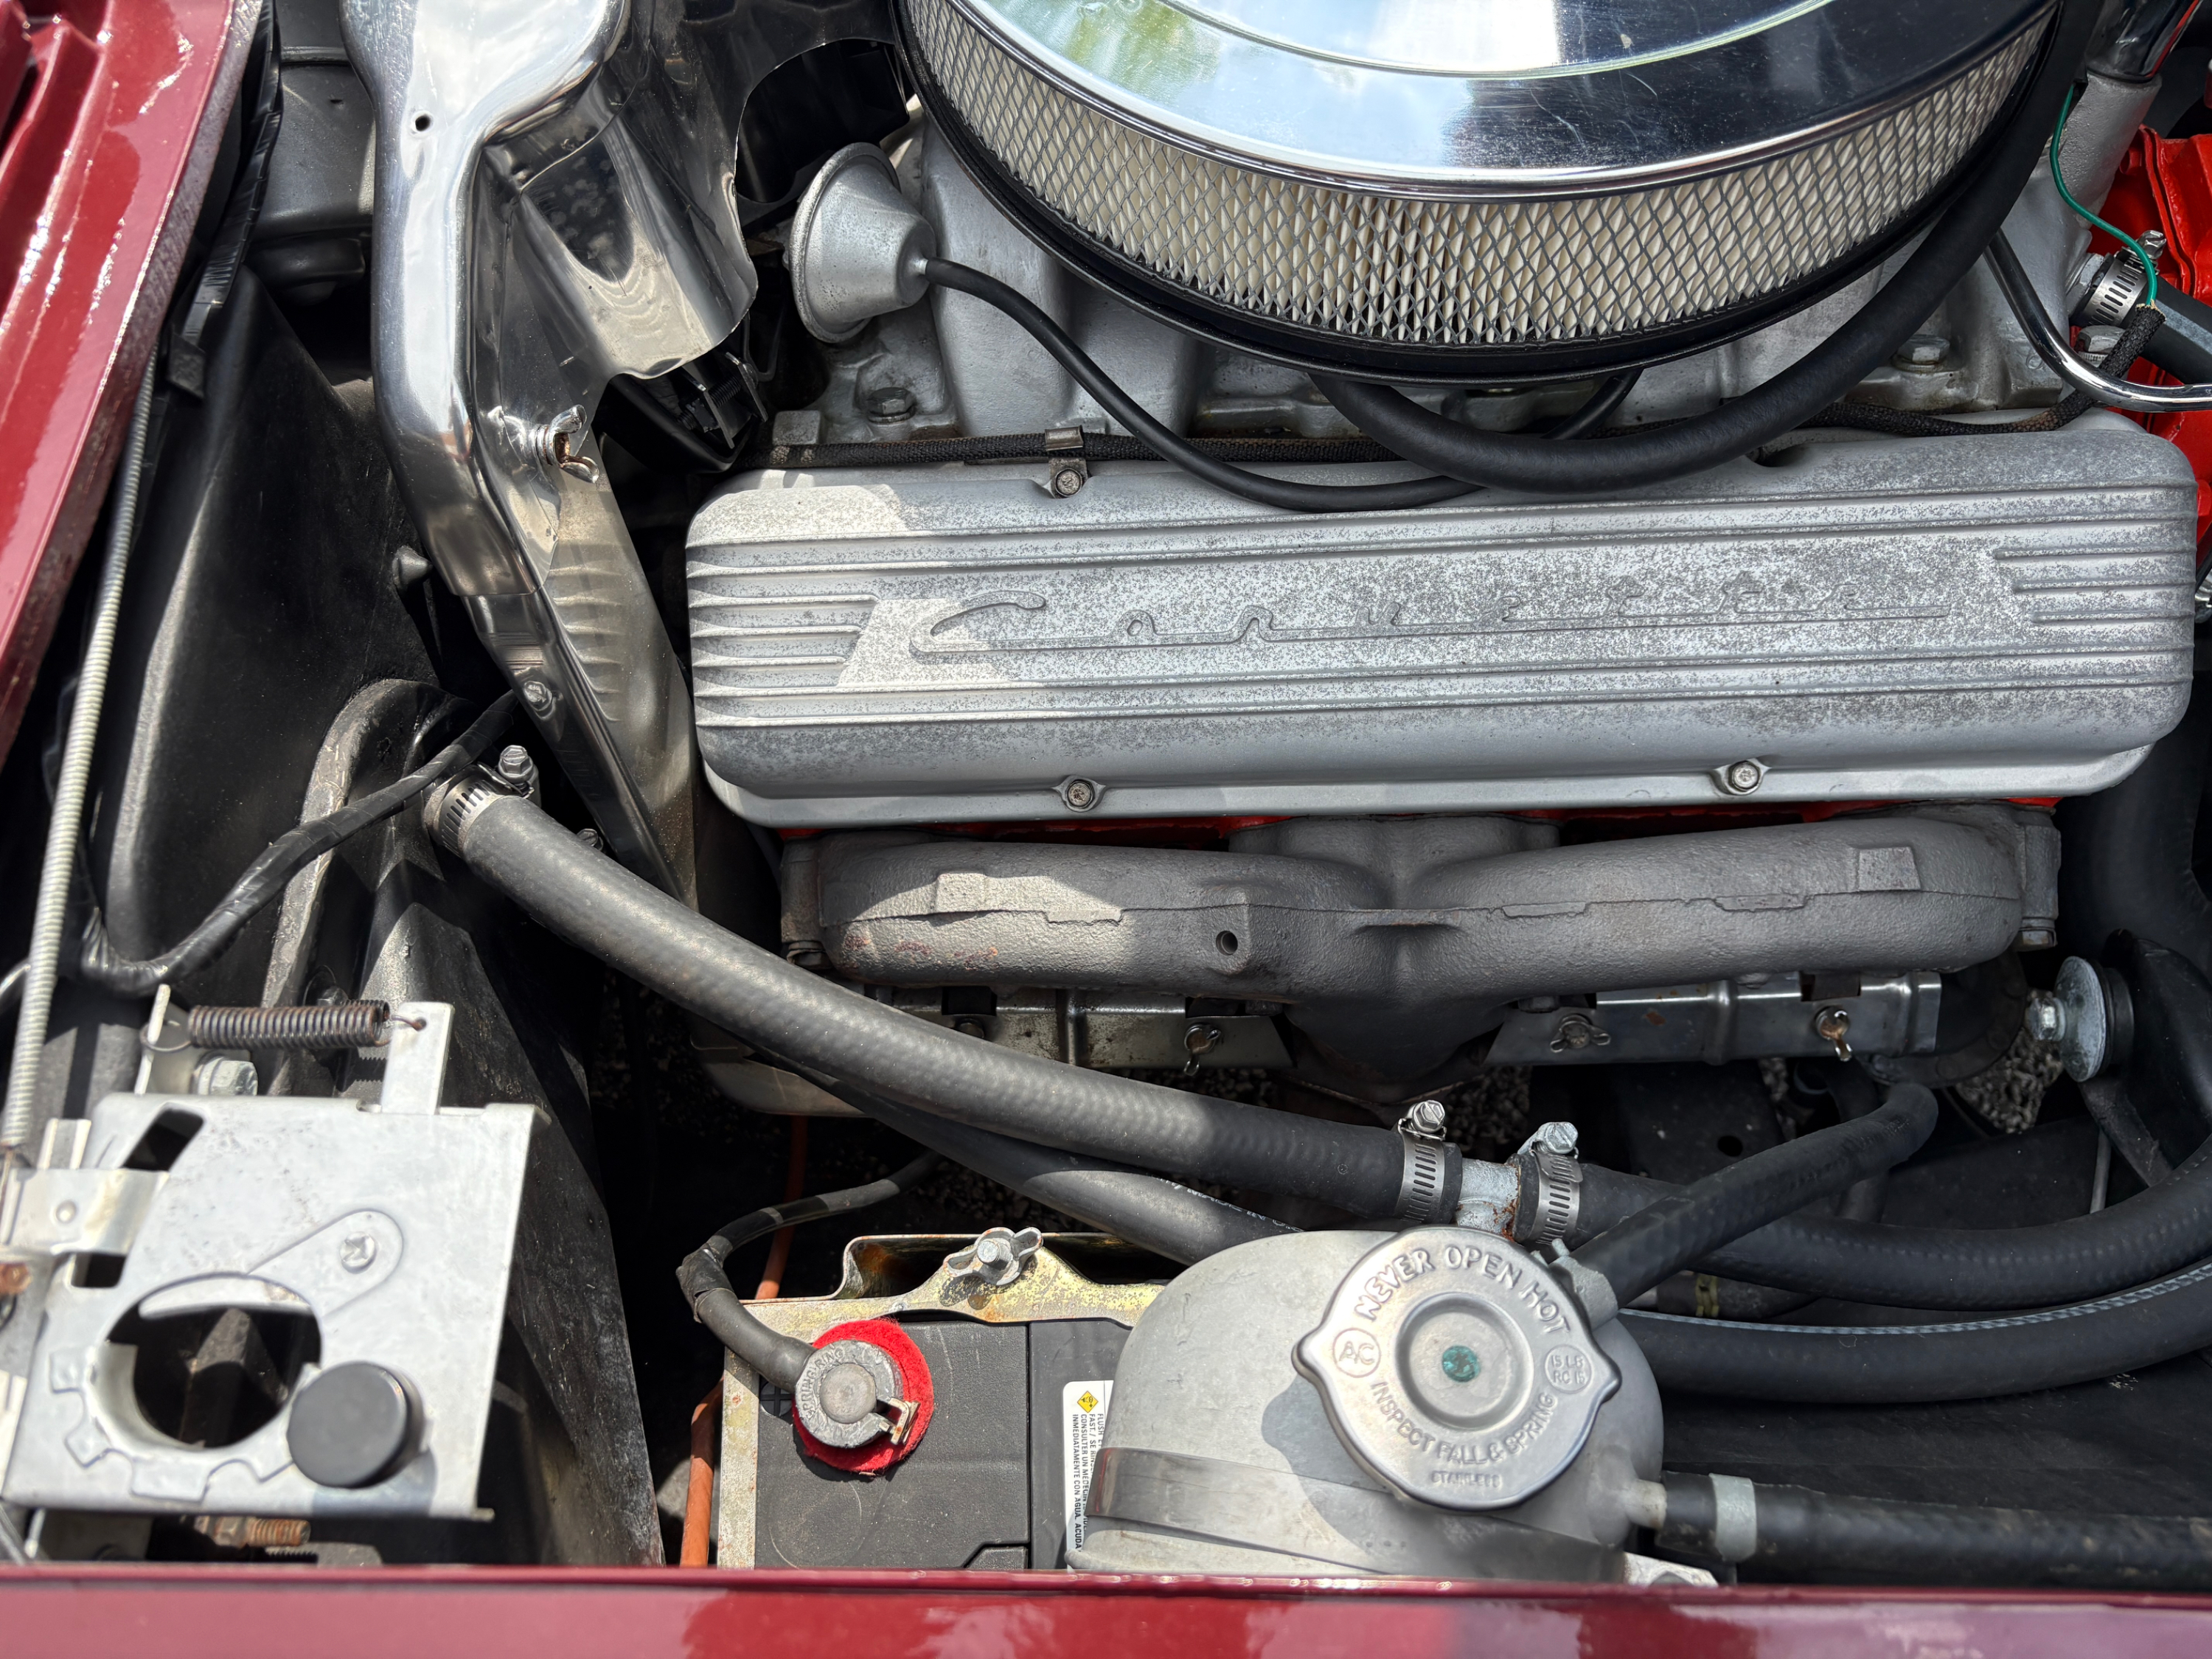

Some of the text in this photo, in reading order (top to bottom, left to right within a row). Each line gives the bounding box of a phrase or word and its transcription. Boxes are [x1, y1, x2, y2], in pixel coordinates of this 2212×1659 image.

[1354, 1244, 1571, 1333] NEVER OPEN HOT
[1338, 1340, 1374, 1366] AC
[1553, 1370, 1571, 1384] RC
[1080, 1413, 1088, 1455] CONSULTER
[1369, 1381, 1436, 1453] INSPECT
[1503, 1391, 1557, 1454] SPRING
[1072, 1414, 1080, 1478] INMEDIATAMENTE
[1082, 1456, 1088, 1467] UN
[1074, 1523, 1082, 1549] ACUDA
